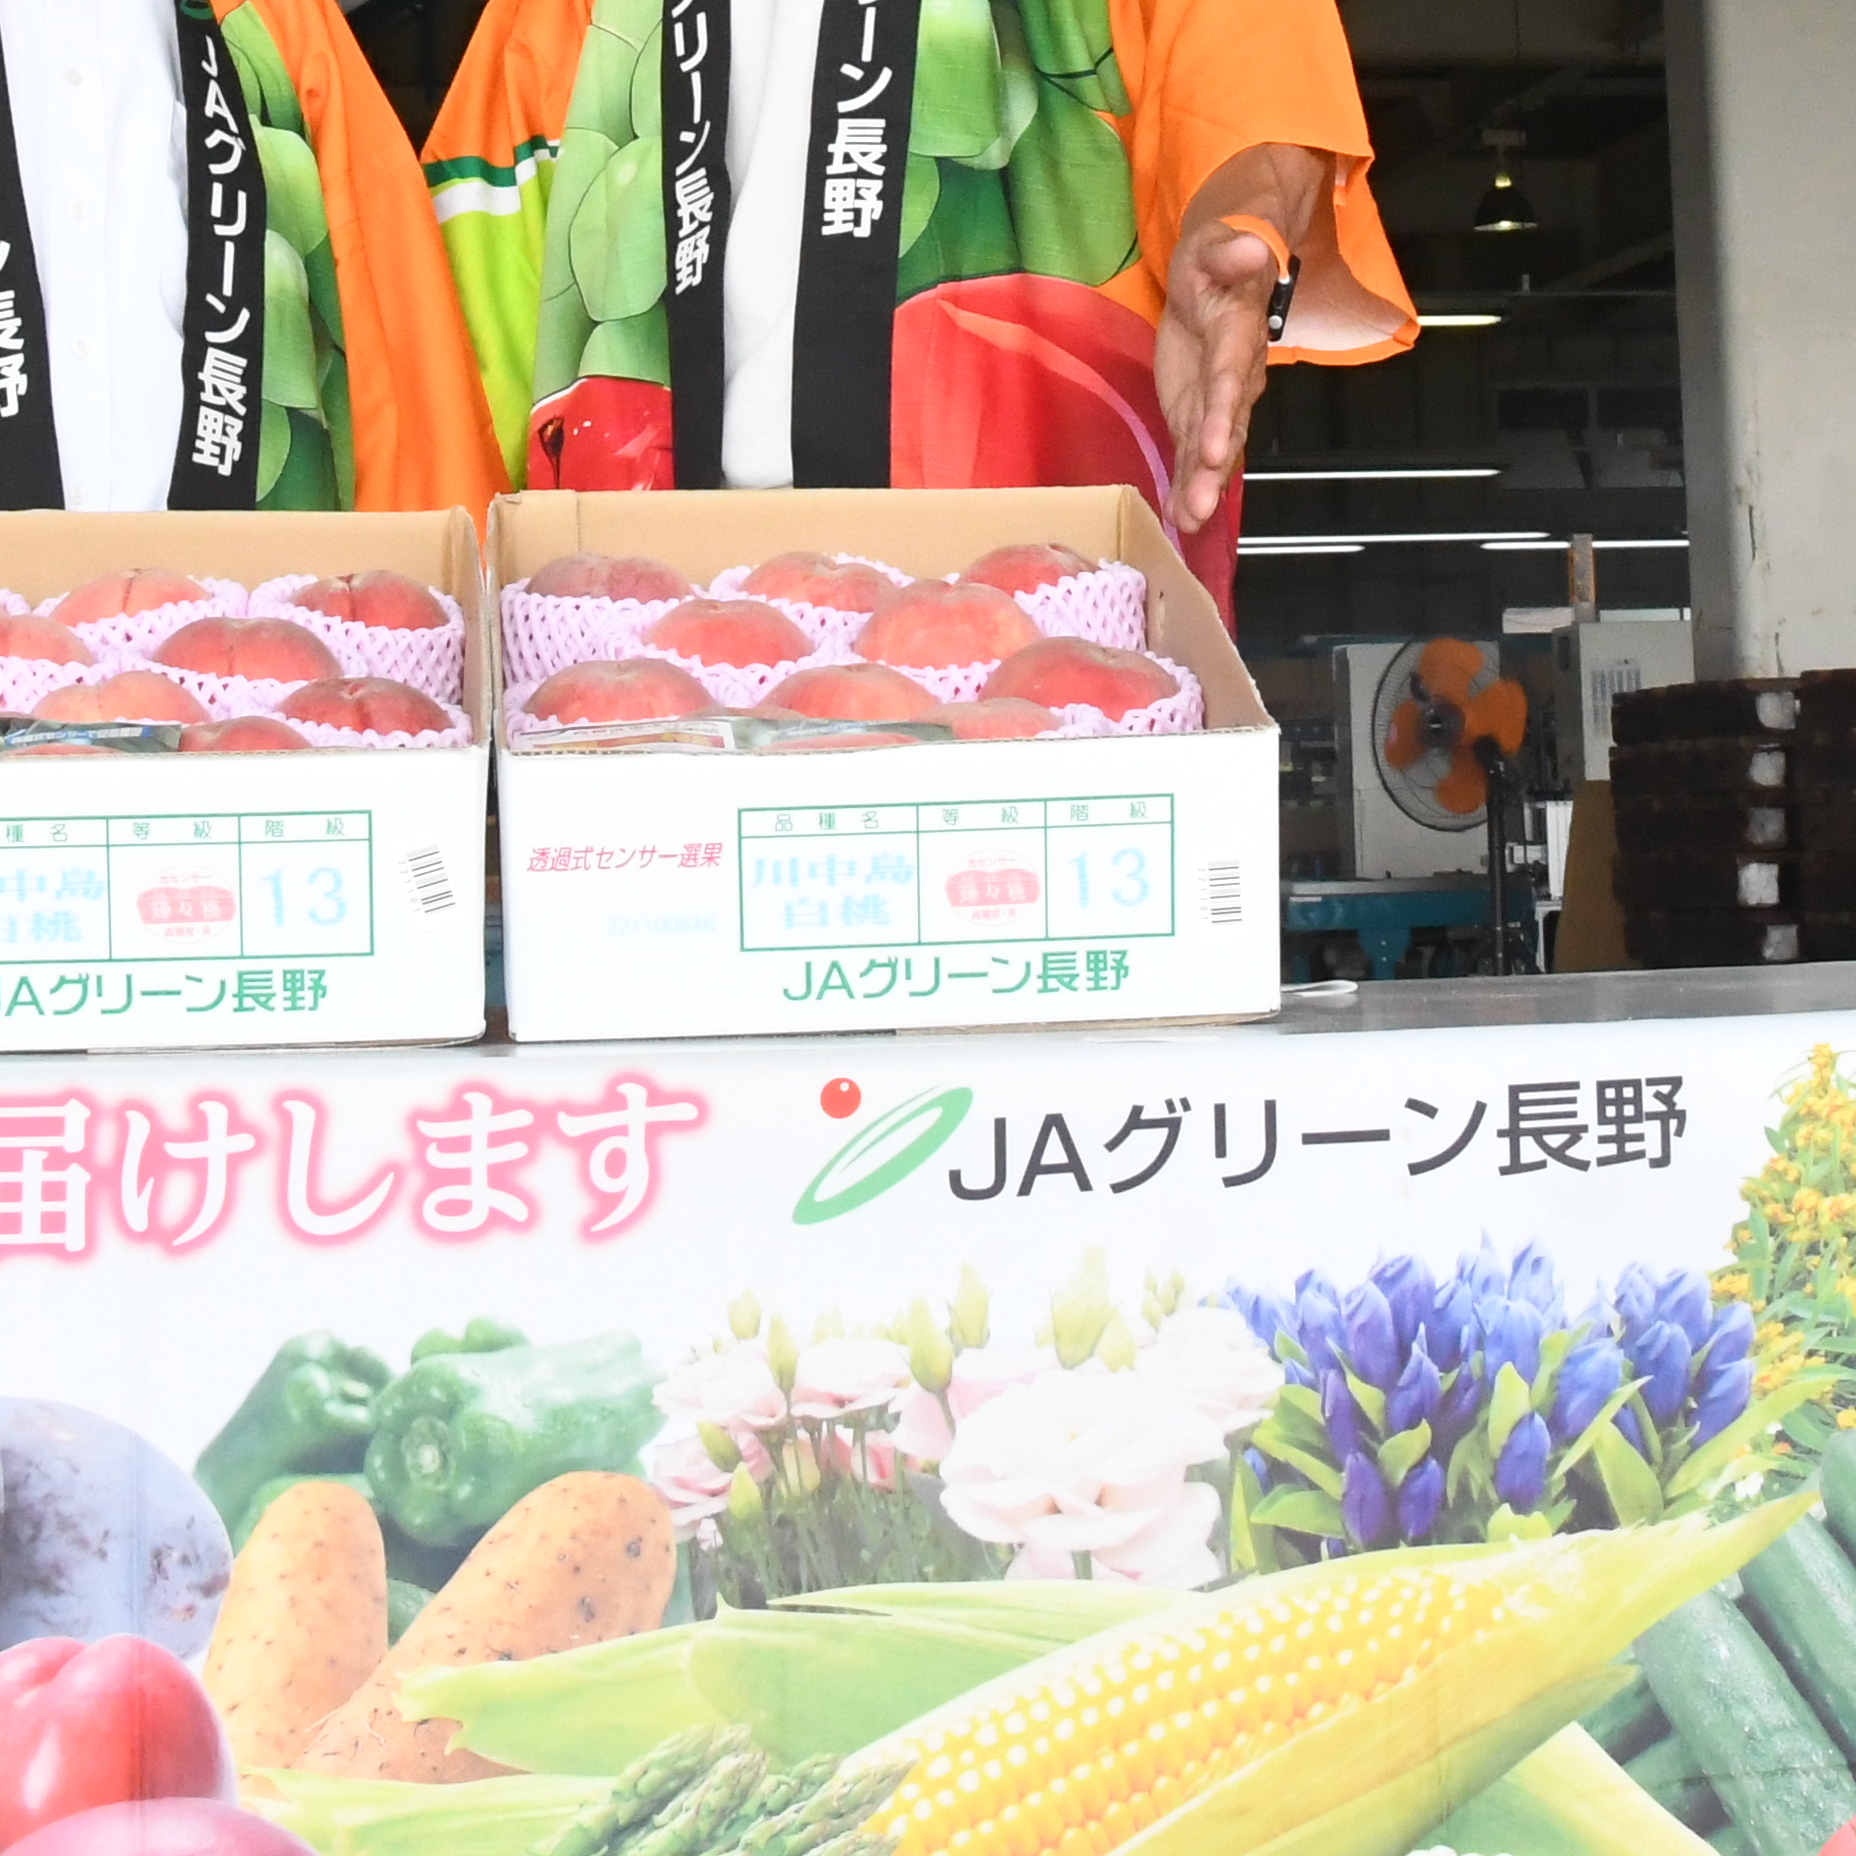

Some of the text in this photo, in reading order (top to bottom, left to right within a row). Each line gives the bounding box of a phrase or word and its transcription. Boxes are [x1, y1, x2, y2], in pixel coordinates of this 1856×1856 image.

[192, 35, 250, 477] JAグリーン長野
[773, 810, 881, 832] 品種名
[526, 842, 724, 873] 透過式センサー選果
[750, 852, 915, 889] 川中島
[1066, 847, 1151, 909] 13
[259, 866, 349, 927] 13
[781, 893, 892, 930] 白桃
[782, 948, 1131, 1002] JAグリーン長野
[948, 1075, 1687, 1200] JAグリーン長野
